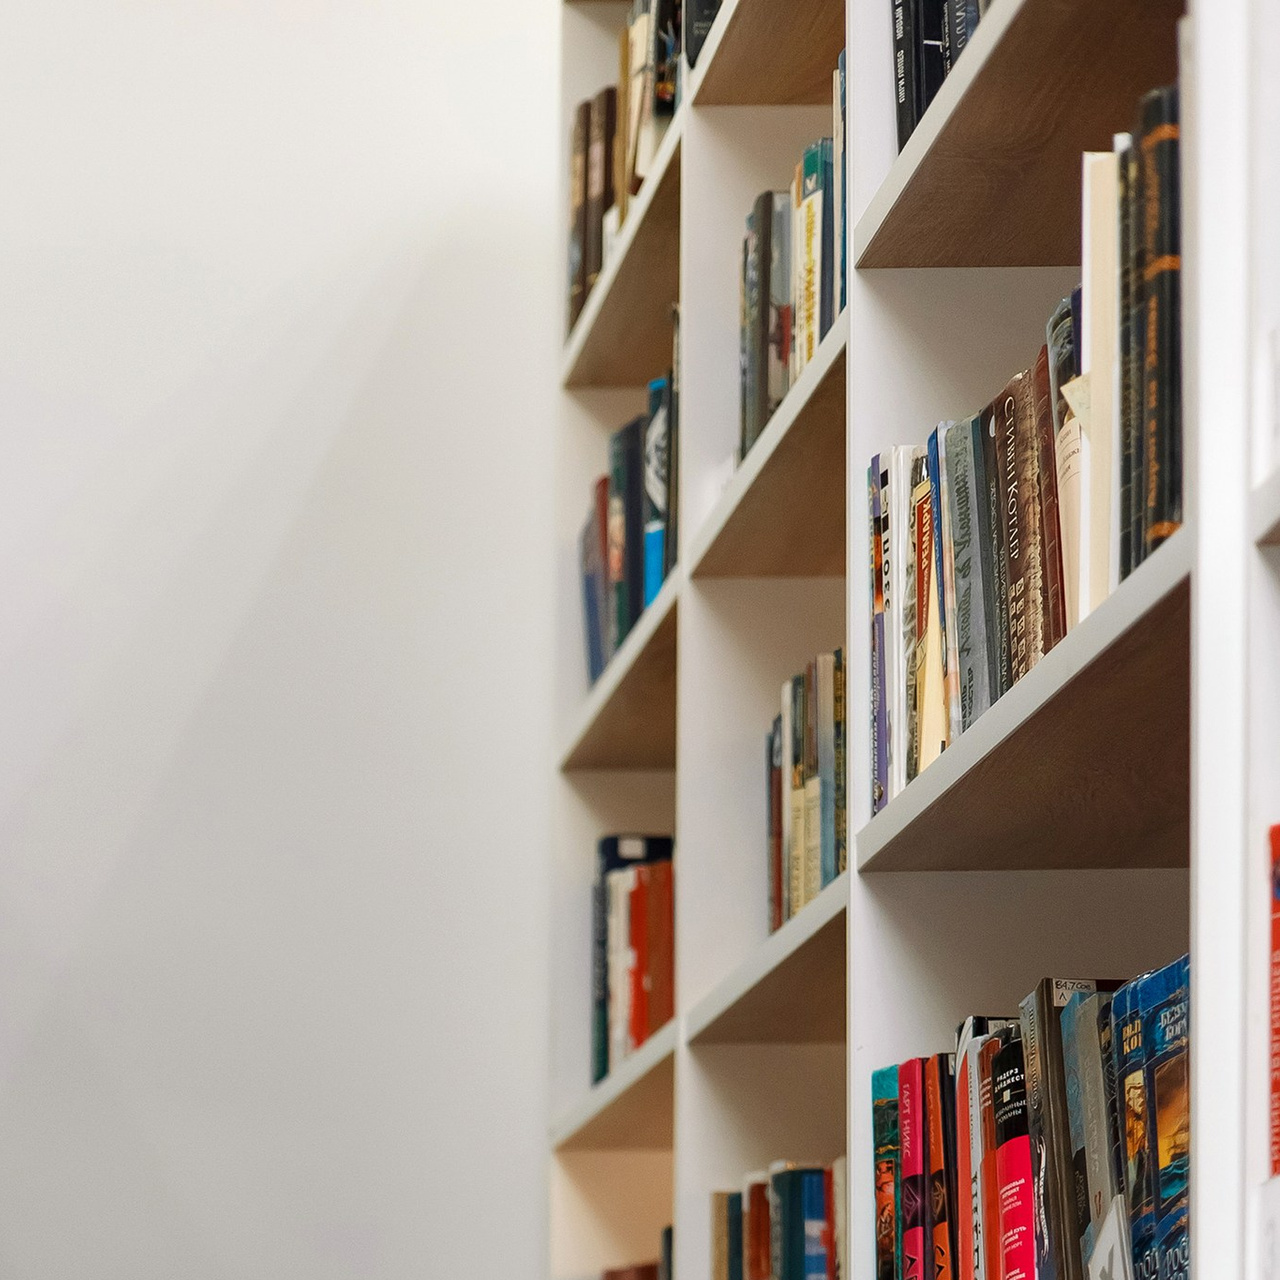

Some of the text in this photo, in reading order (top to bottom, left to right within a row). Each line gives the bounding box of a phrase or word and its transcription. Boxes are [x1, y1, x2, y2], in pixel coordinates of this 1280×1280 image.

[1004, 395, 1019, 560] СТИВЕН КОТЛЕР
[921, 498, 933, 568] РЕМАРК
[882, 537, 891, 613] ЭЗОП
[902, 1083, 912, 1160] ГАРТ НИКС
[994, 1073, 1025, 1094] ДАЙДЖЕСТ
